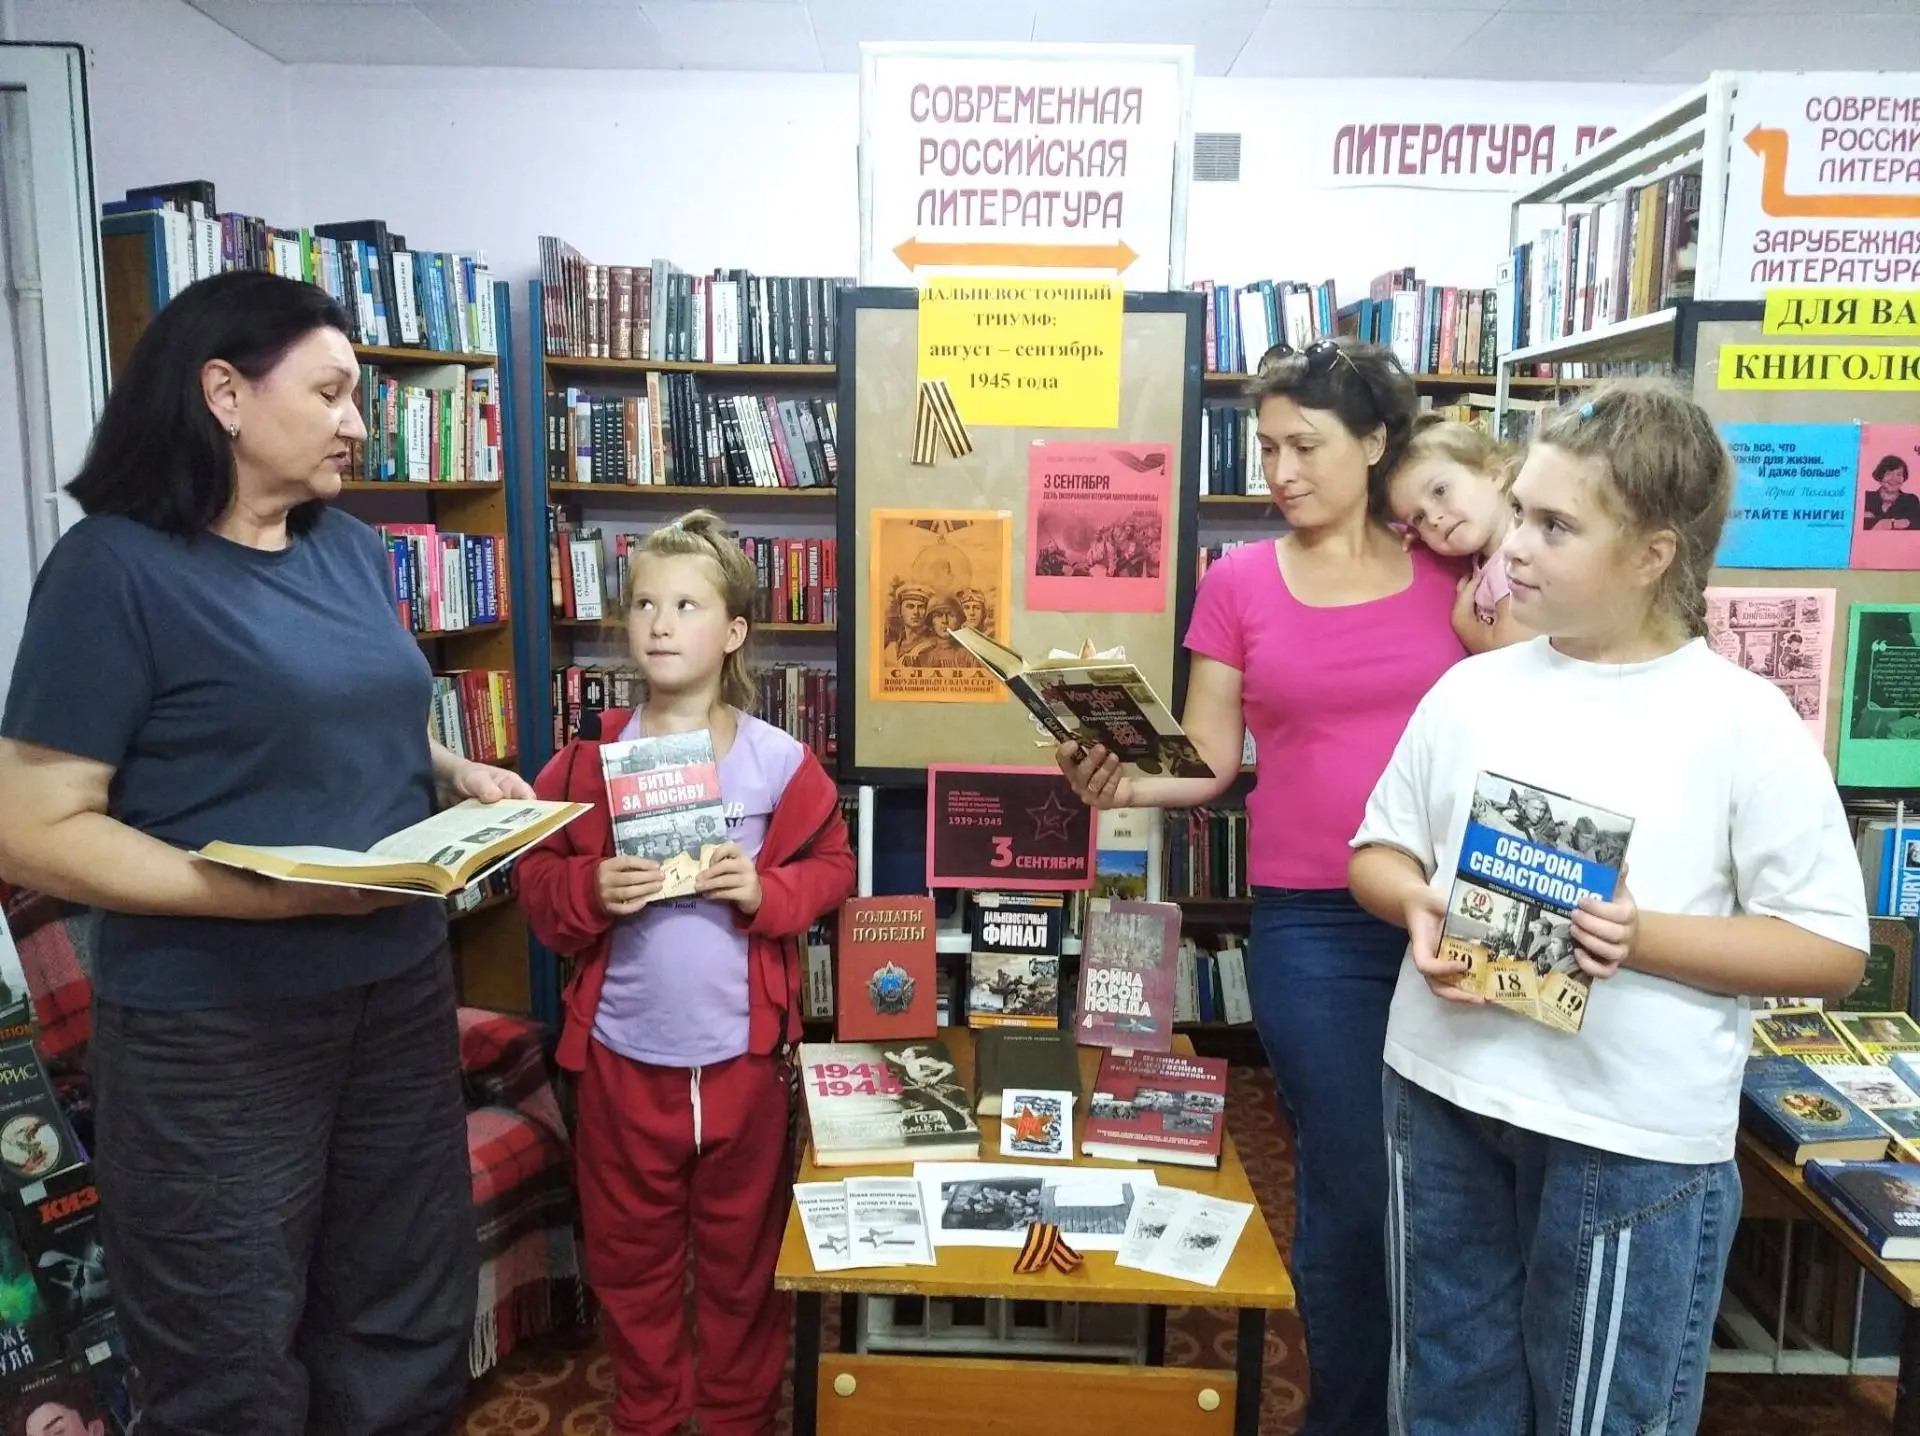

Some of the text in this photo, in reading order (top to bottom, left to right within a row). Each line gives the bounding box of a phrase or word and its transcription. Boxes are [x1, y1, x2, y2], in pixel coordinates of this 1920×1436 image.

[910, 83, 1143, 125] СОВРЕМЕННАЯ
[919, 134, 1127, 177] РОССИЙСКАЯ
[1333, 123, 1555, 176] ЛИТЕРАТУРА
[917, 188, 1123, 228] ЛИТЕРАТУРА
[922, 283, 1112, 302] ДАЛЬНЕВОСТОЧНЫЙ
[973, 312, 1057, 328] ТРИУМФ:
[1777, 299, 1856, 331] ДЛЯ
[930, 343, 993, 361] август
[1015, 341, 1104, 360] сентябрь
[969, 373, 1058, 390] 1945 года
[1778, 444, 1796, 452] что
[1044, 474, 1110, 490] 3 СЕНТЯБРЯ
[1728, 509, 1788, 520] ИТАЙТЕ
[890, 669, 985, 678] СЛАВА
[638, 770, 685, 792] БИТВА
[622, 783, 704, 811] ЗА МОСКВУ
[990, 836, 1085, 869] 3 СЕНТЯБРЯ
[1496, 837, 1583, 883] ОБОРОНА
[1899, 872, 1920, 917] BURY
[855, 909, 923, 923] СОЛДАТЫ
[983, 911, 1048, 926] ДАЛЬНЕВОСТОЧНЫЙ
[853, 925, 927, 943] ПОБЕДЫ
[982, 923, 1048, 948] ФИНАЛ
[1087, 967, 1144, 988] ВОЙНА
[1496, 973, 1522, 991] 18
[1085, 984, 1143, 1002] НАРОД
[1556, 987, 1583, 1012] 19
[1084, 998, 1152, 1017] ПОБЕДА
[1081, 1014, 1093, 1029] 4
